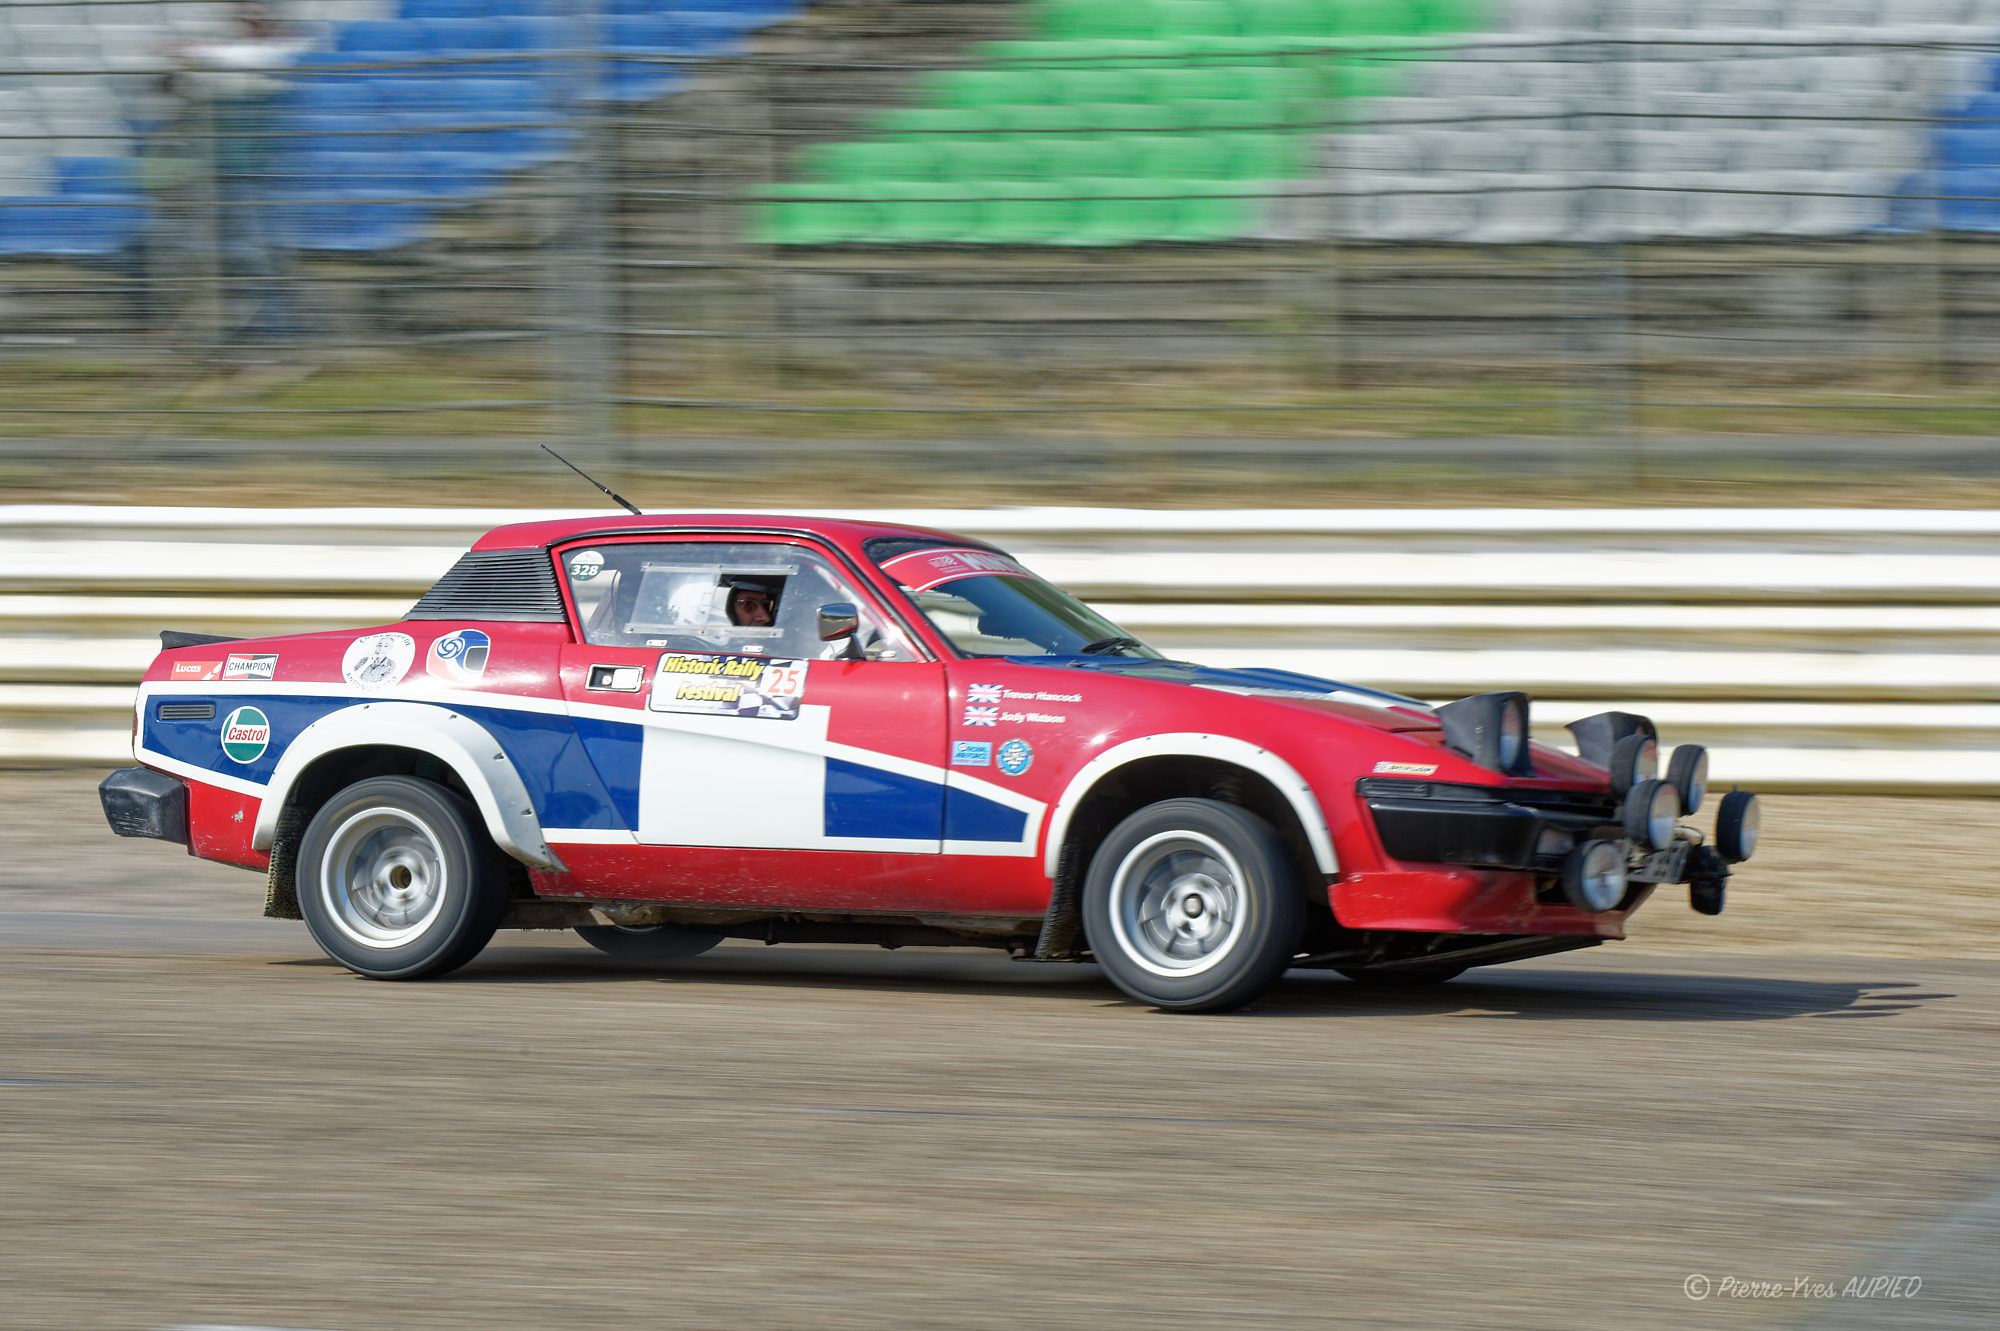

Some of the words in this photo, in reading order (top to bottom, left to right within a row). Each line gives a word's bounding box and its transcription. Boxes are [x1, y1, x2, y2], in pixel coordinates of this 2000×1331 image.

[571, 564, 600, 576] 328
[175, 663, 202, 673] Lucas
[228, 662, 273, 672] CHAMPION
[662, 655, 723, 675] Historic
[722, 658, 766, 682] Rally
[767, 668, 801, 695] 25
[675, 680, 742, 702] Festival
[228, 727, 267, 741] Castrol
